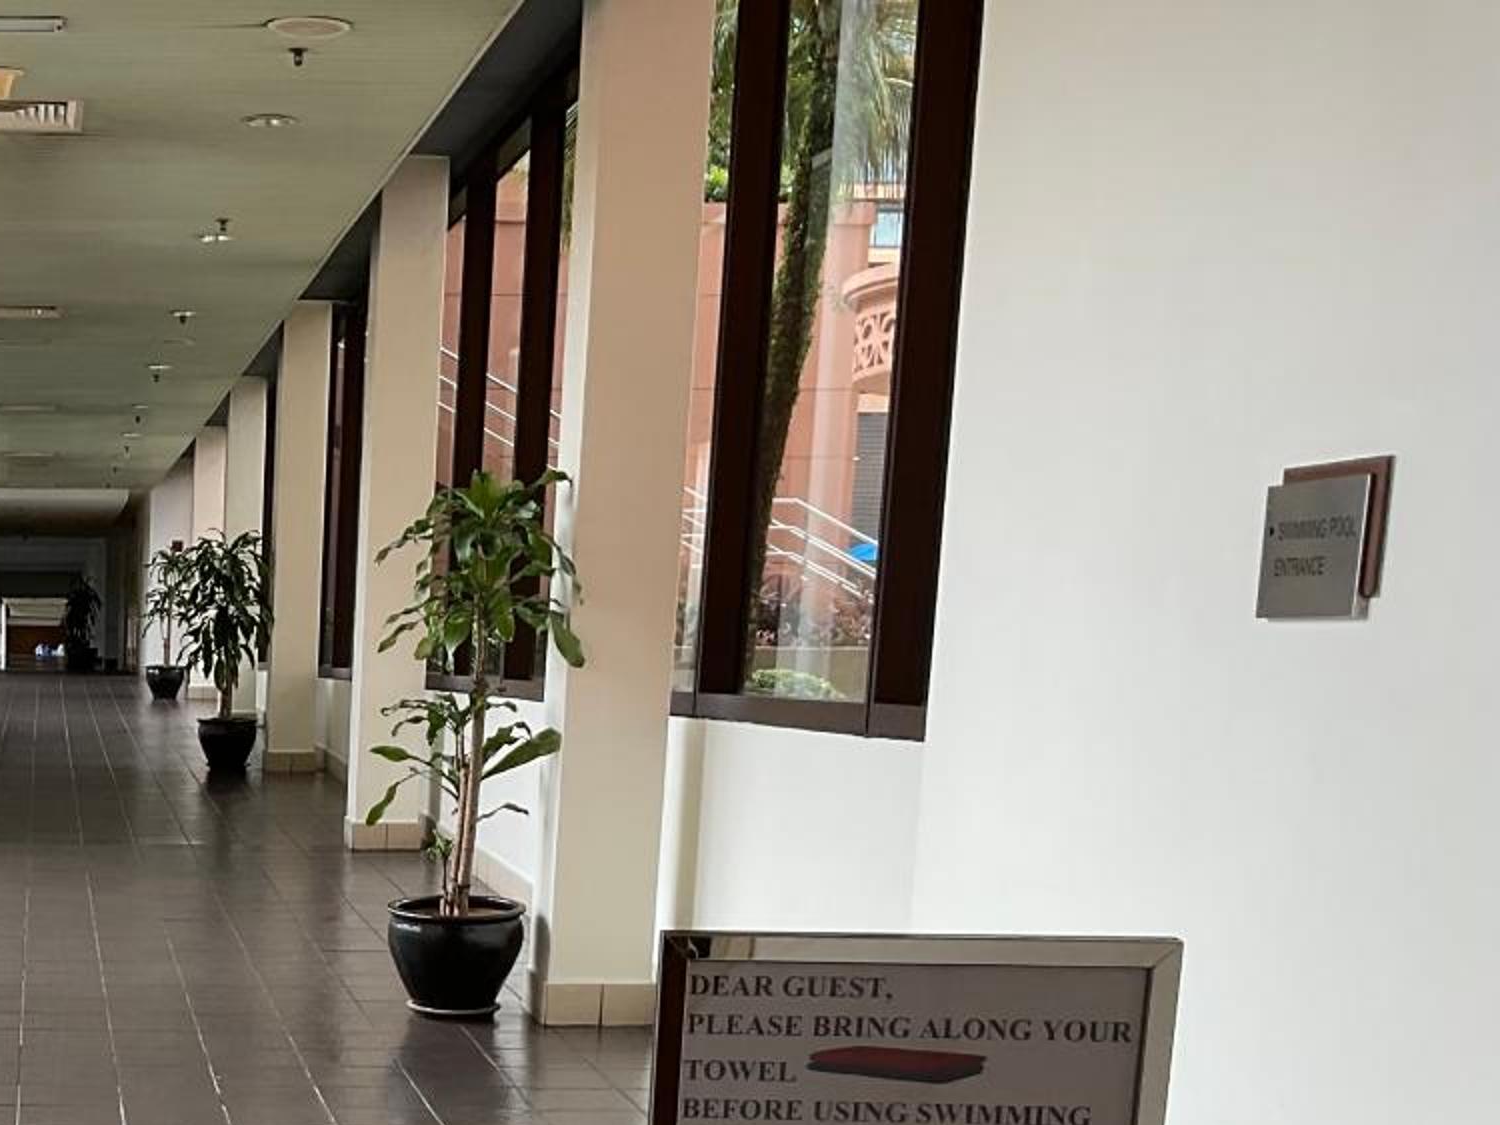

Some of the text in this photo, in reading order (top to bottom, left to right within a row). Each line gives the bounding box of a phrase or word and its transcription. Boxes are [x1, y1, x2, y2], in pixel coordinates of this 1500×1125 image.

[1274, 556, 1325, 576] ENTRANCE
[690, 975, 893, 1000] DEAR GUEST,
[688, 1015, 1132, 1043] PLEASE BRING ALONG YOUR
[683, 1059, 797, 1082] TOWEL
[682, 1099, 803, 1121] BEFORE
[813, 1100, 909, 1124] USING
